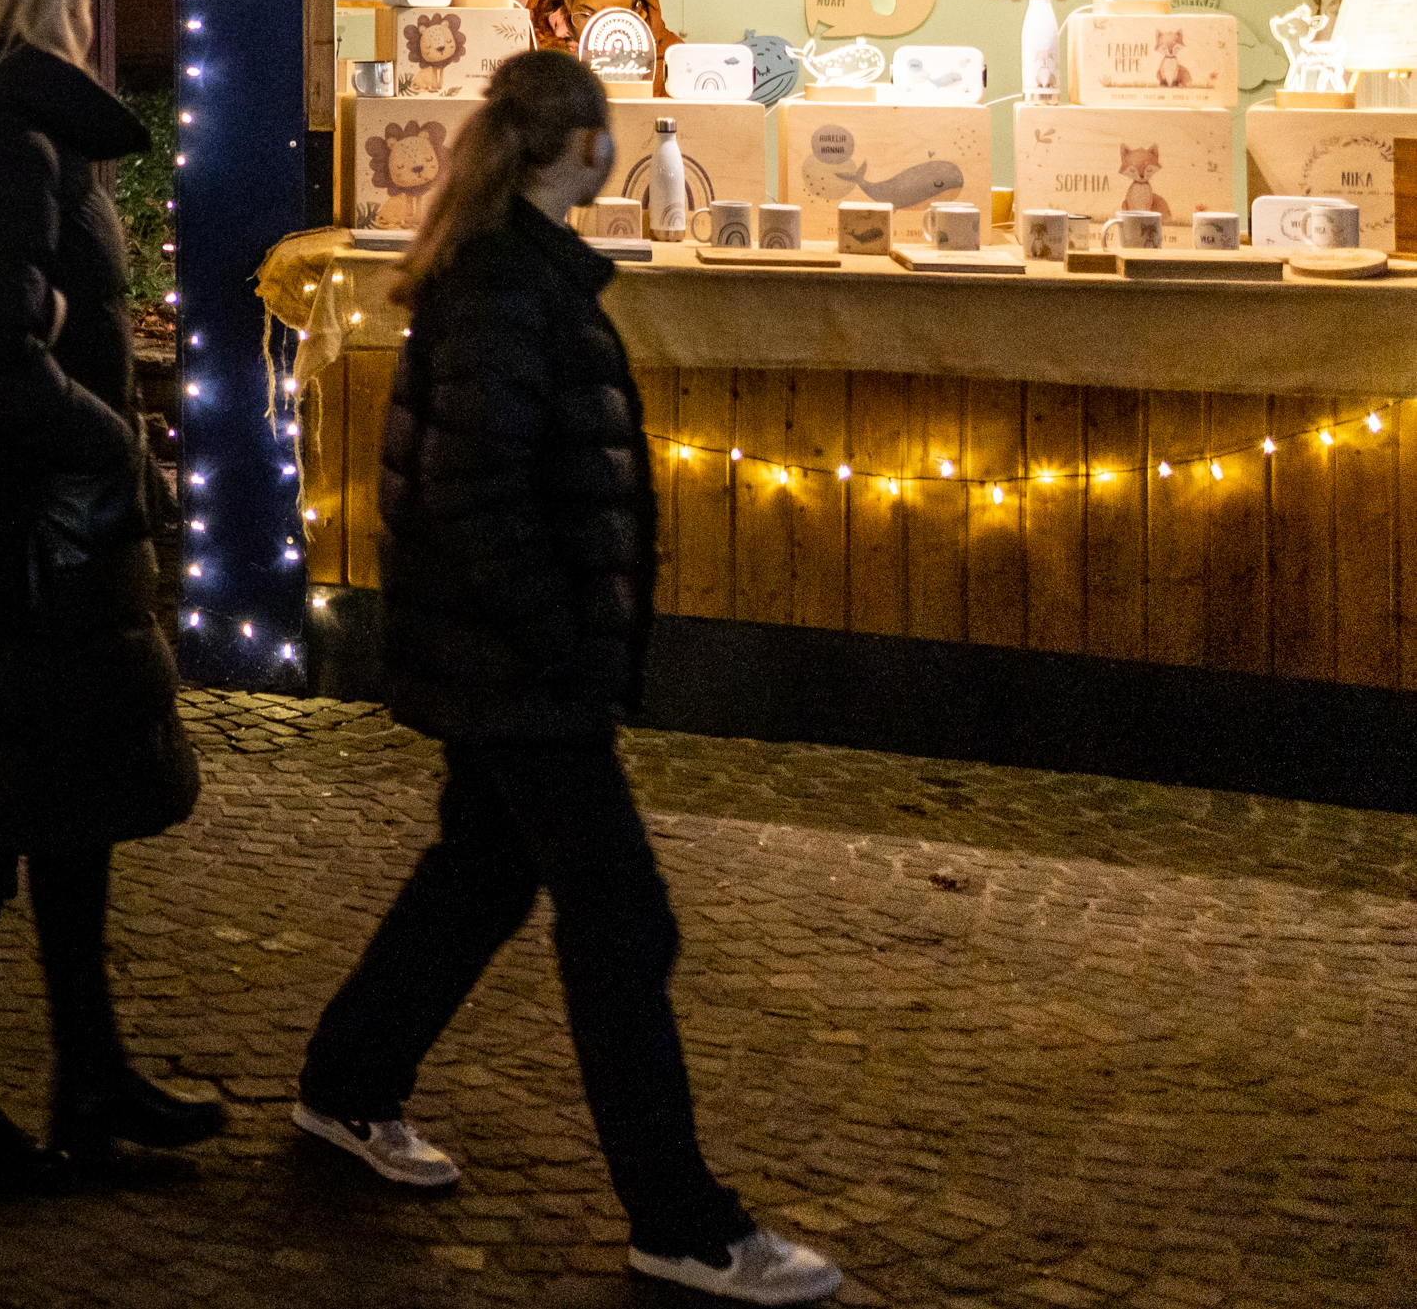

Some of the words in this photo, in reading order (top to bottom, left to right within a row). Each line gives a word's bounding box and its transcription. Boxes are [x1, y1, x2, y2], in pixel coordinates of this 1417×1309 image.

[1107, 43, 1148, 58] FABIAN
[1115, 58, 1141, 73] PEPE
[1055, 174, 1110, 192] SOPHIA
[1341, 171, 1373, 187] NIKA
